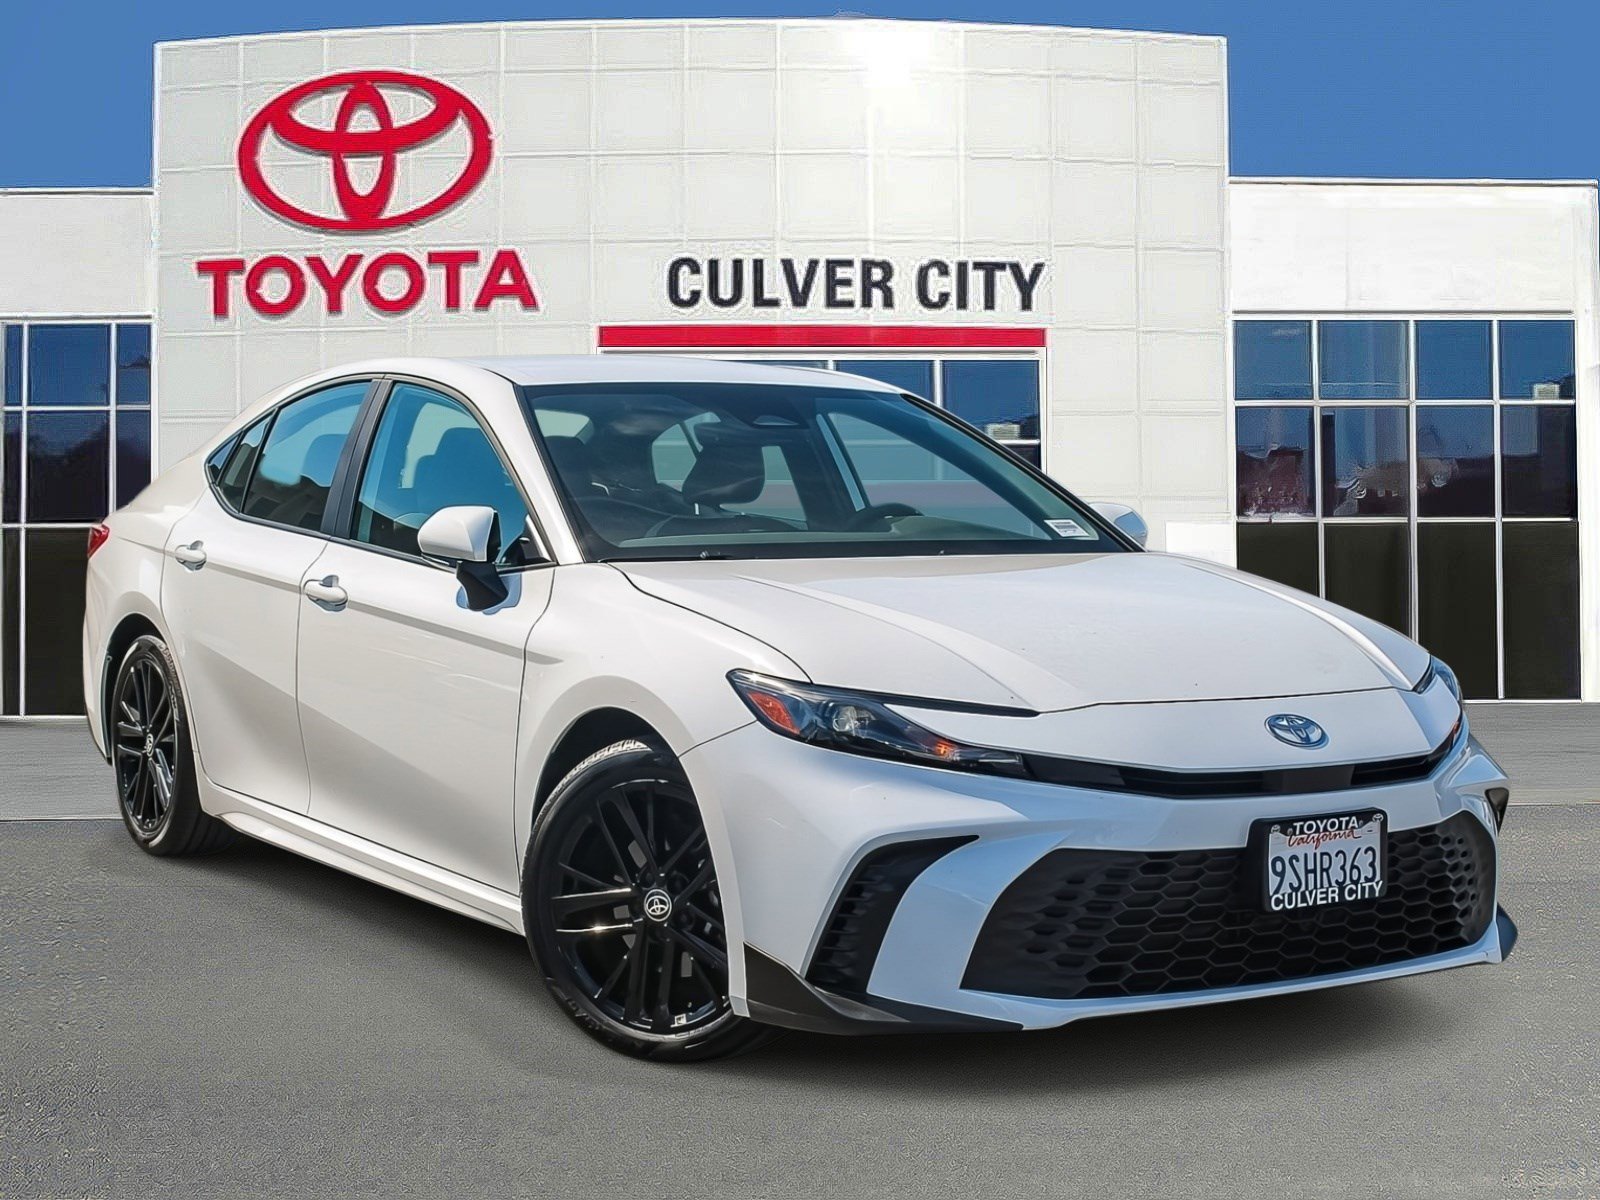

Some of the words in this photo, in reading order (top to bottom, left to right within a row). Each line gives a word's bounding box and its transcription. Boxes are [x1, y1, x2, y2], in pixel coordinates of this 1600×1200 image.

[196, 249, 540, 317] TOYOTA
[667, 256, 895, 309] CULVER
[915, 259, 1046, 312] CITY
[1293, 816, 1359, 836] TOYOTA
[1270, 846, 1377, 896] 9SHR363
[1270, 887, 1339, 911] CULVER
[1344, 880, 1383, 901] CITY
